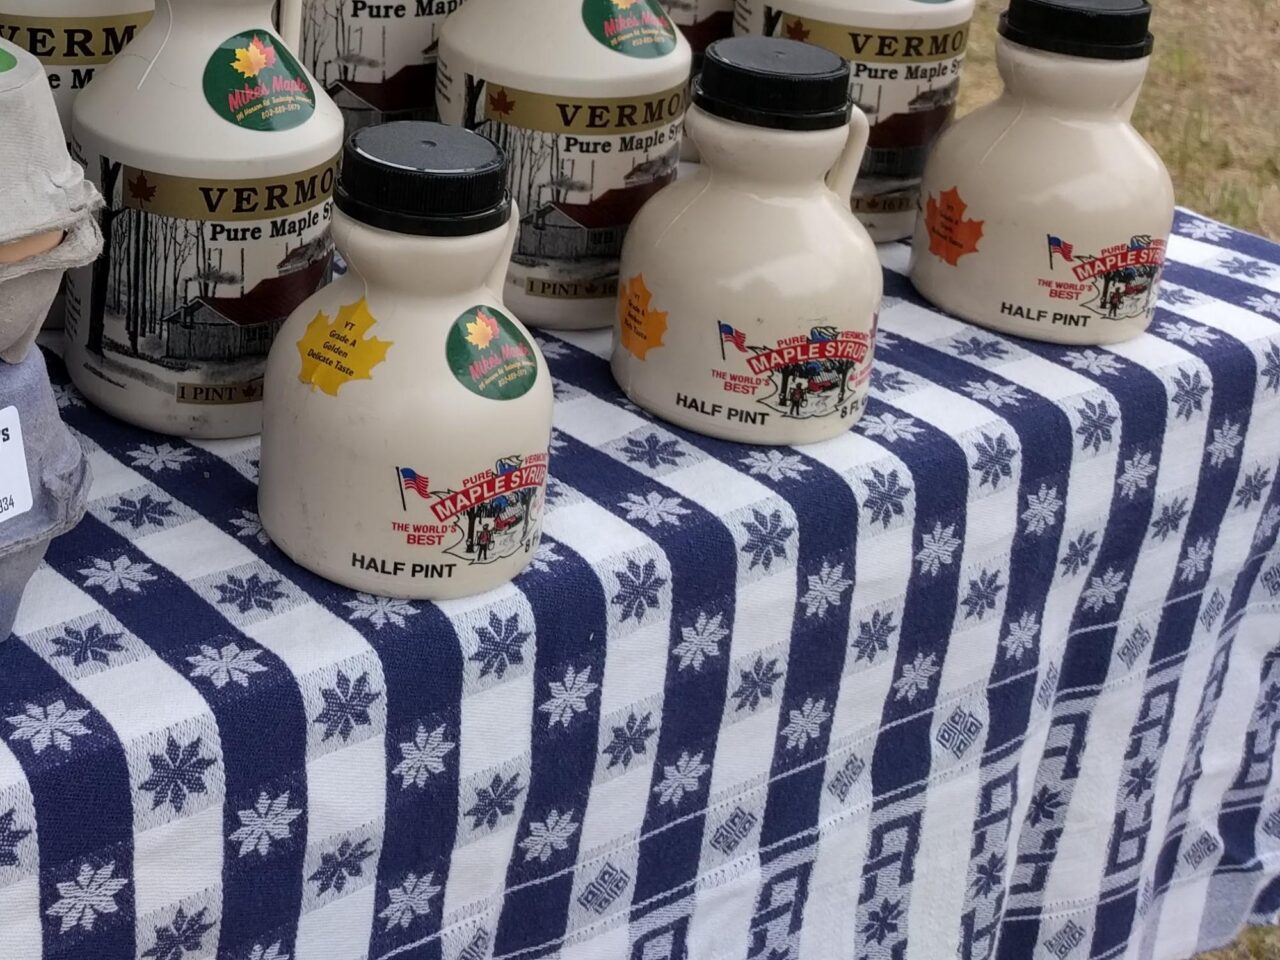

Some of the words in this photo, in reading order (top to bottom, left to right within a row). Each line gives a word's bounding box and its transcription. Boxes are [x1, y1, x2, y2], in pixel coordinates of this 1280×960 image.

[350, 0, 406, 18] Pure
[853, 62, 898, 81] Pure
[904, 60, 947, 82] Maple
[564, 137, 612, 154] Pure
[618, 129, 664, 156] Maple
[209, 223, 262, 242] Pure
[269, 212, 319, 239] Maple
[1100, 243, 1127, 257] PURE
[1077, 251, 1136, 281] MAPLE
[540, 281, 579, 295] PINT
[1037, 278, 1054, 287] THE
[1055, 279, 1093, 291] WORLD'S
[1049, 289, 1082, 301] BEST
[1000, 302, 1048, 322] HALF
[1052, 312, 1091, 328] PINT
[329, 329, 350, 345] Grade
[350, 339, 358, 348] A
[776, 335, 806, 348] PURE
[322, 340, 349, 359] Golden
[752, 343, 820, 372] MAPLE
[824, 341, 868, 359] SYRUP
[307, 348, 334, 368] Delicate
[334, 360, 355, 377] Taste
[711, 369, 729, 379] THE
[730, 372, 770, 387] WORLD'S
[192, 387, 237, 401] PINT
[723, 382, 759, 395] BEST
[676, 392, 723, 416] HALF
[726, 407, 770, 426] PINT
[462, 469, 493, 488] PURE
[434, 471, 508, 520] MAPLE
[391, 522, 411, 533] THE
[412, 523, 457, 534] WORLD'S
[406, 534, 445, 546] BEST
[351, 552, 406, 576] HALF
[411, 563, 457, 578] PINT
